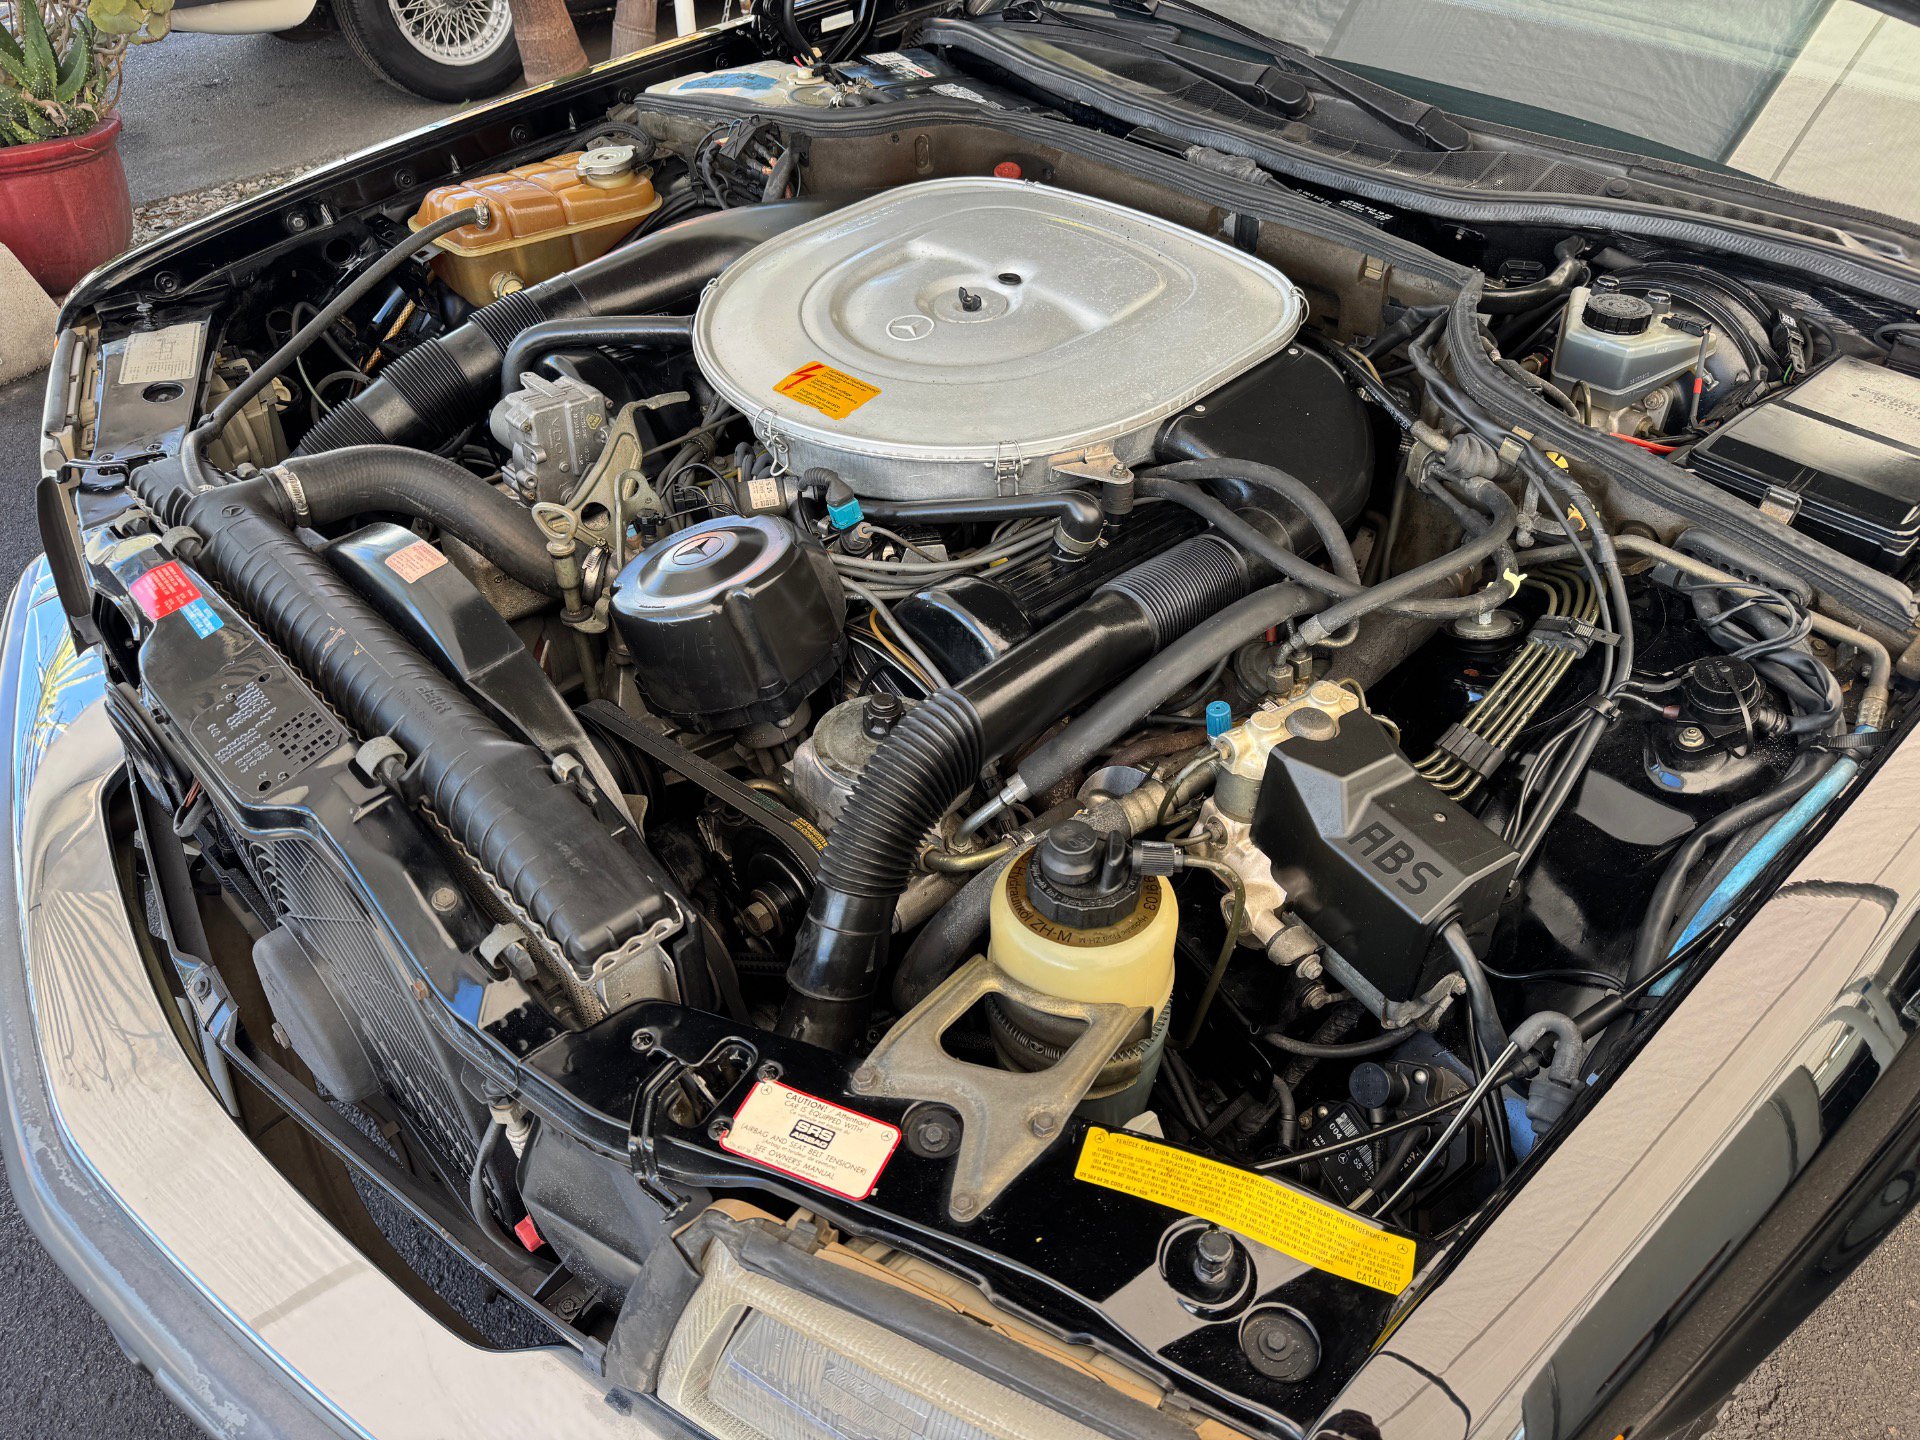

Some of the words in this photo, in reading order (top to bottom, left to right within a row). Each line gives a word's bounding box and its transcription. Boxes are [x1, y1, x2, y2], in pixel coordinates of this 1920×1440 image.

[1347, 821, 1443, 895] ABS
[1030, 919, 1073, 944] ZH-M
[784, 1100, 798, 1110] CAR
[800, 1105, 807, 1113] IS
[808, 1108, 842, 1126] EQUIPPED
[844, 1120, 864, 1133] WITH
[786, 1092, 828, 1112] CAUTION!
[835, 1110, 871, 1129] Attention!
[790, 1130, 829, 1150] AIRBAG
[795, 1121, 835, 1142] SRS
[1329, 1122, 1343, 1140] 004
[771, 1133, 788, 1146] AND
[790, 1139, 807, 1152] SEAT
[808, 1146, 823, 1158] BELT
[755, 1144, 767, 1153] SEE
[803, 1162, 835, 1181] MANUAL
[1115, 1138, 1138, 1148] VEHICLE
[1140, 1144, 1169, 1157] EMISSION
[1171, 1153, 1197, 1165] CONTROL
[1199, 1162, 1239, 1180] INFORMATION
[1356, 1271, 1398, 1292] CATALYST
